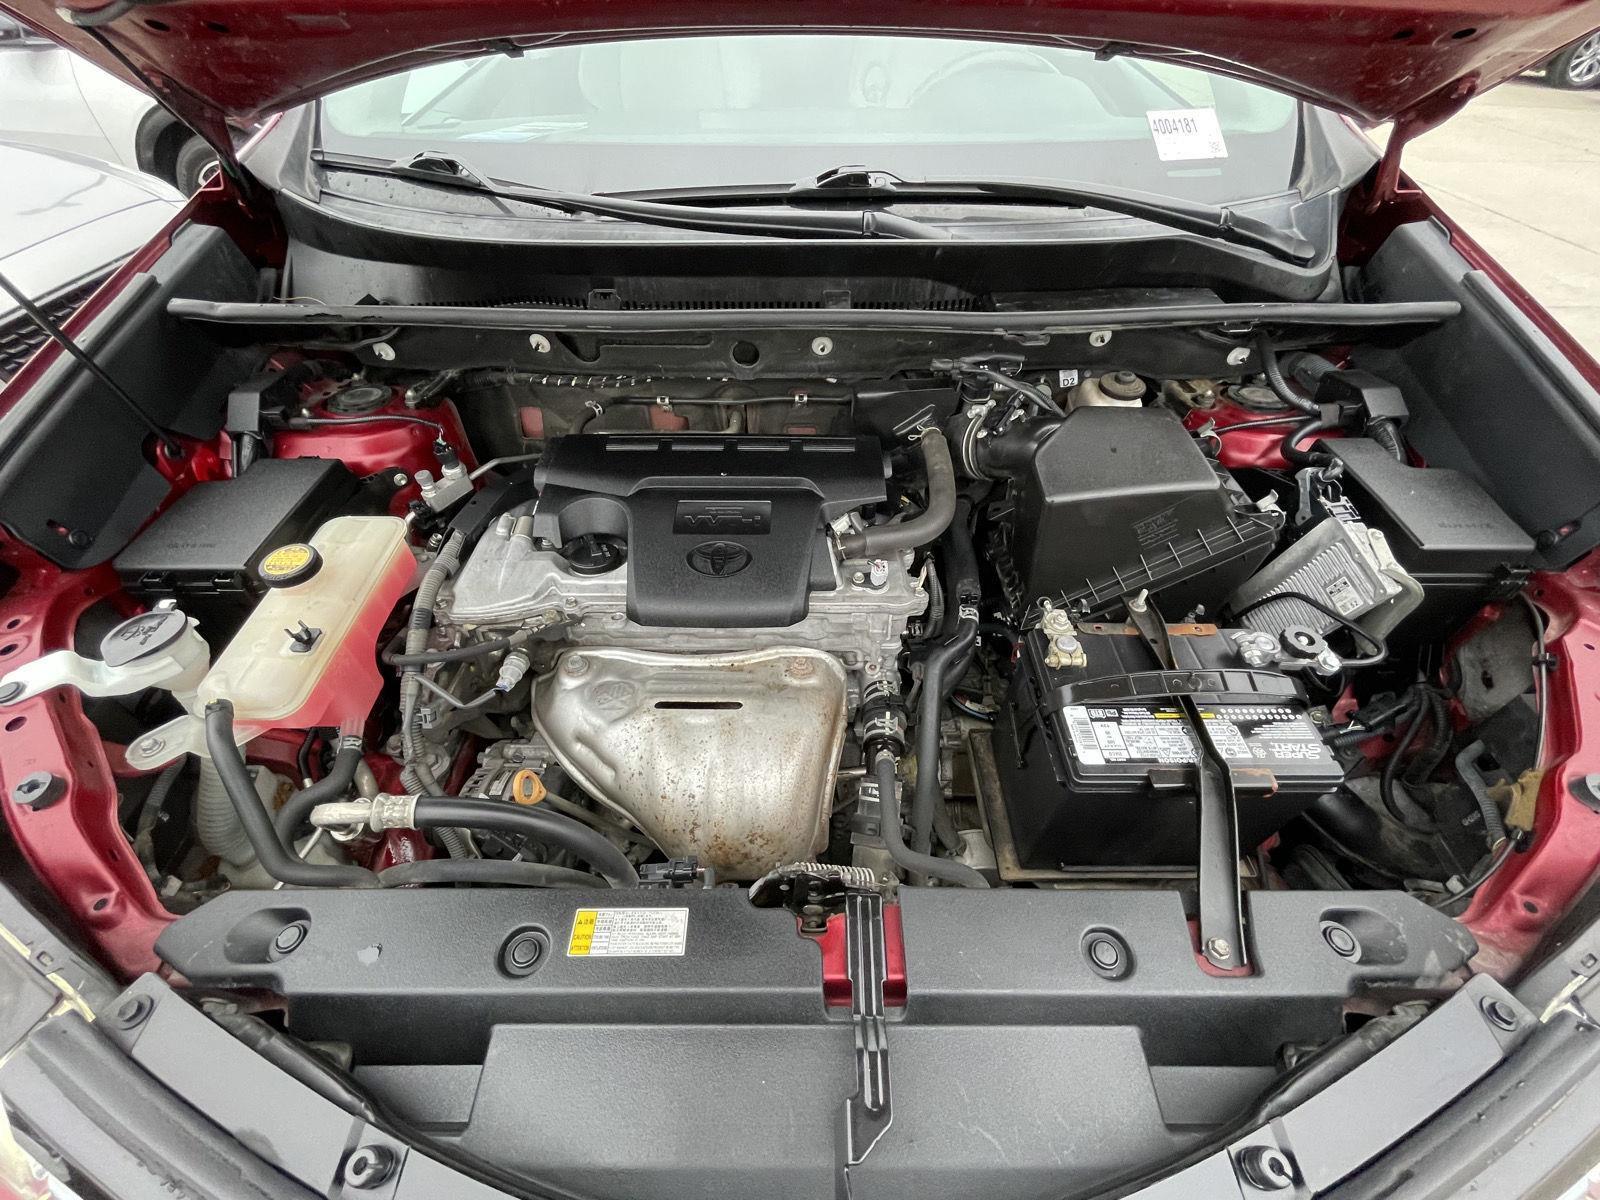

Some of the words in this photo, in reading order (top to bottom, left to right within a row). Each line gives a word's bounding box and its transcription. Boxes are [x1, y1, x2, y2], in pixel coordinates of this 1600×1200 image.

[1152, 117, 1198, 135] 4004181
[1062, 377, 1075, 387] D2
[1271, 743, 1322, 753] START
[1274, 751, 1321, 760] SUPER
